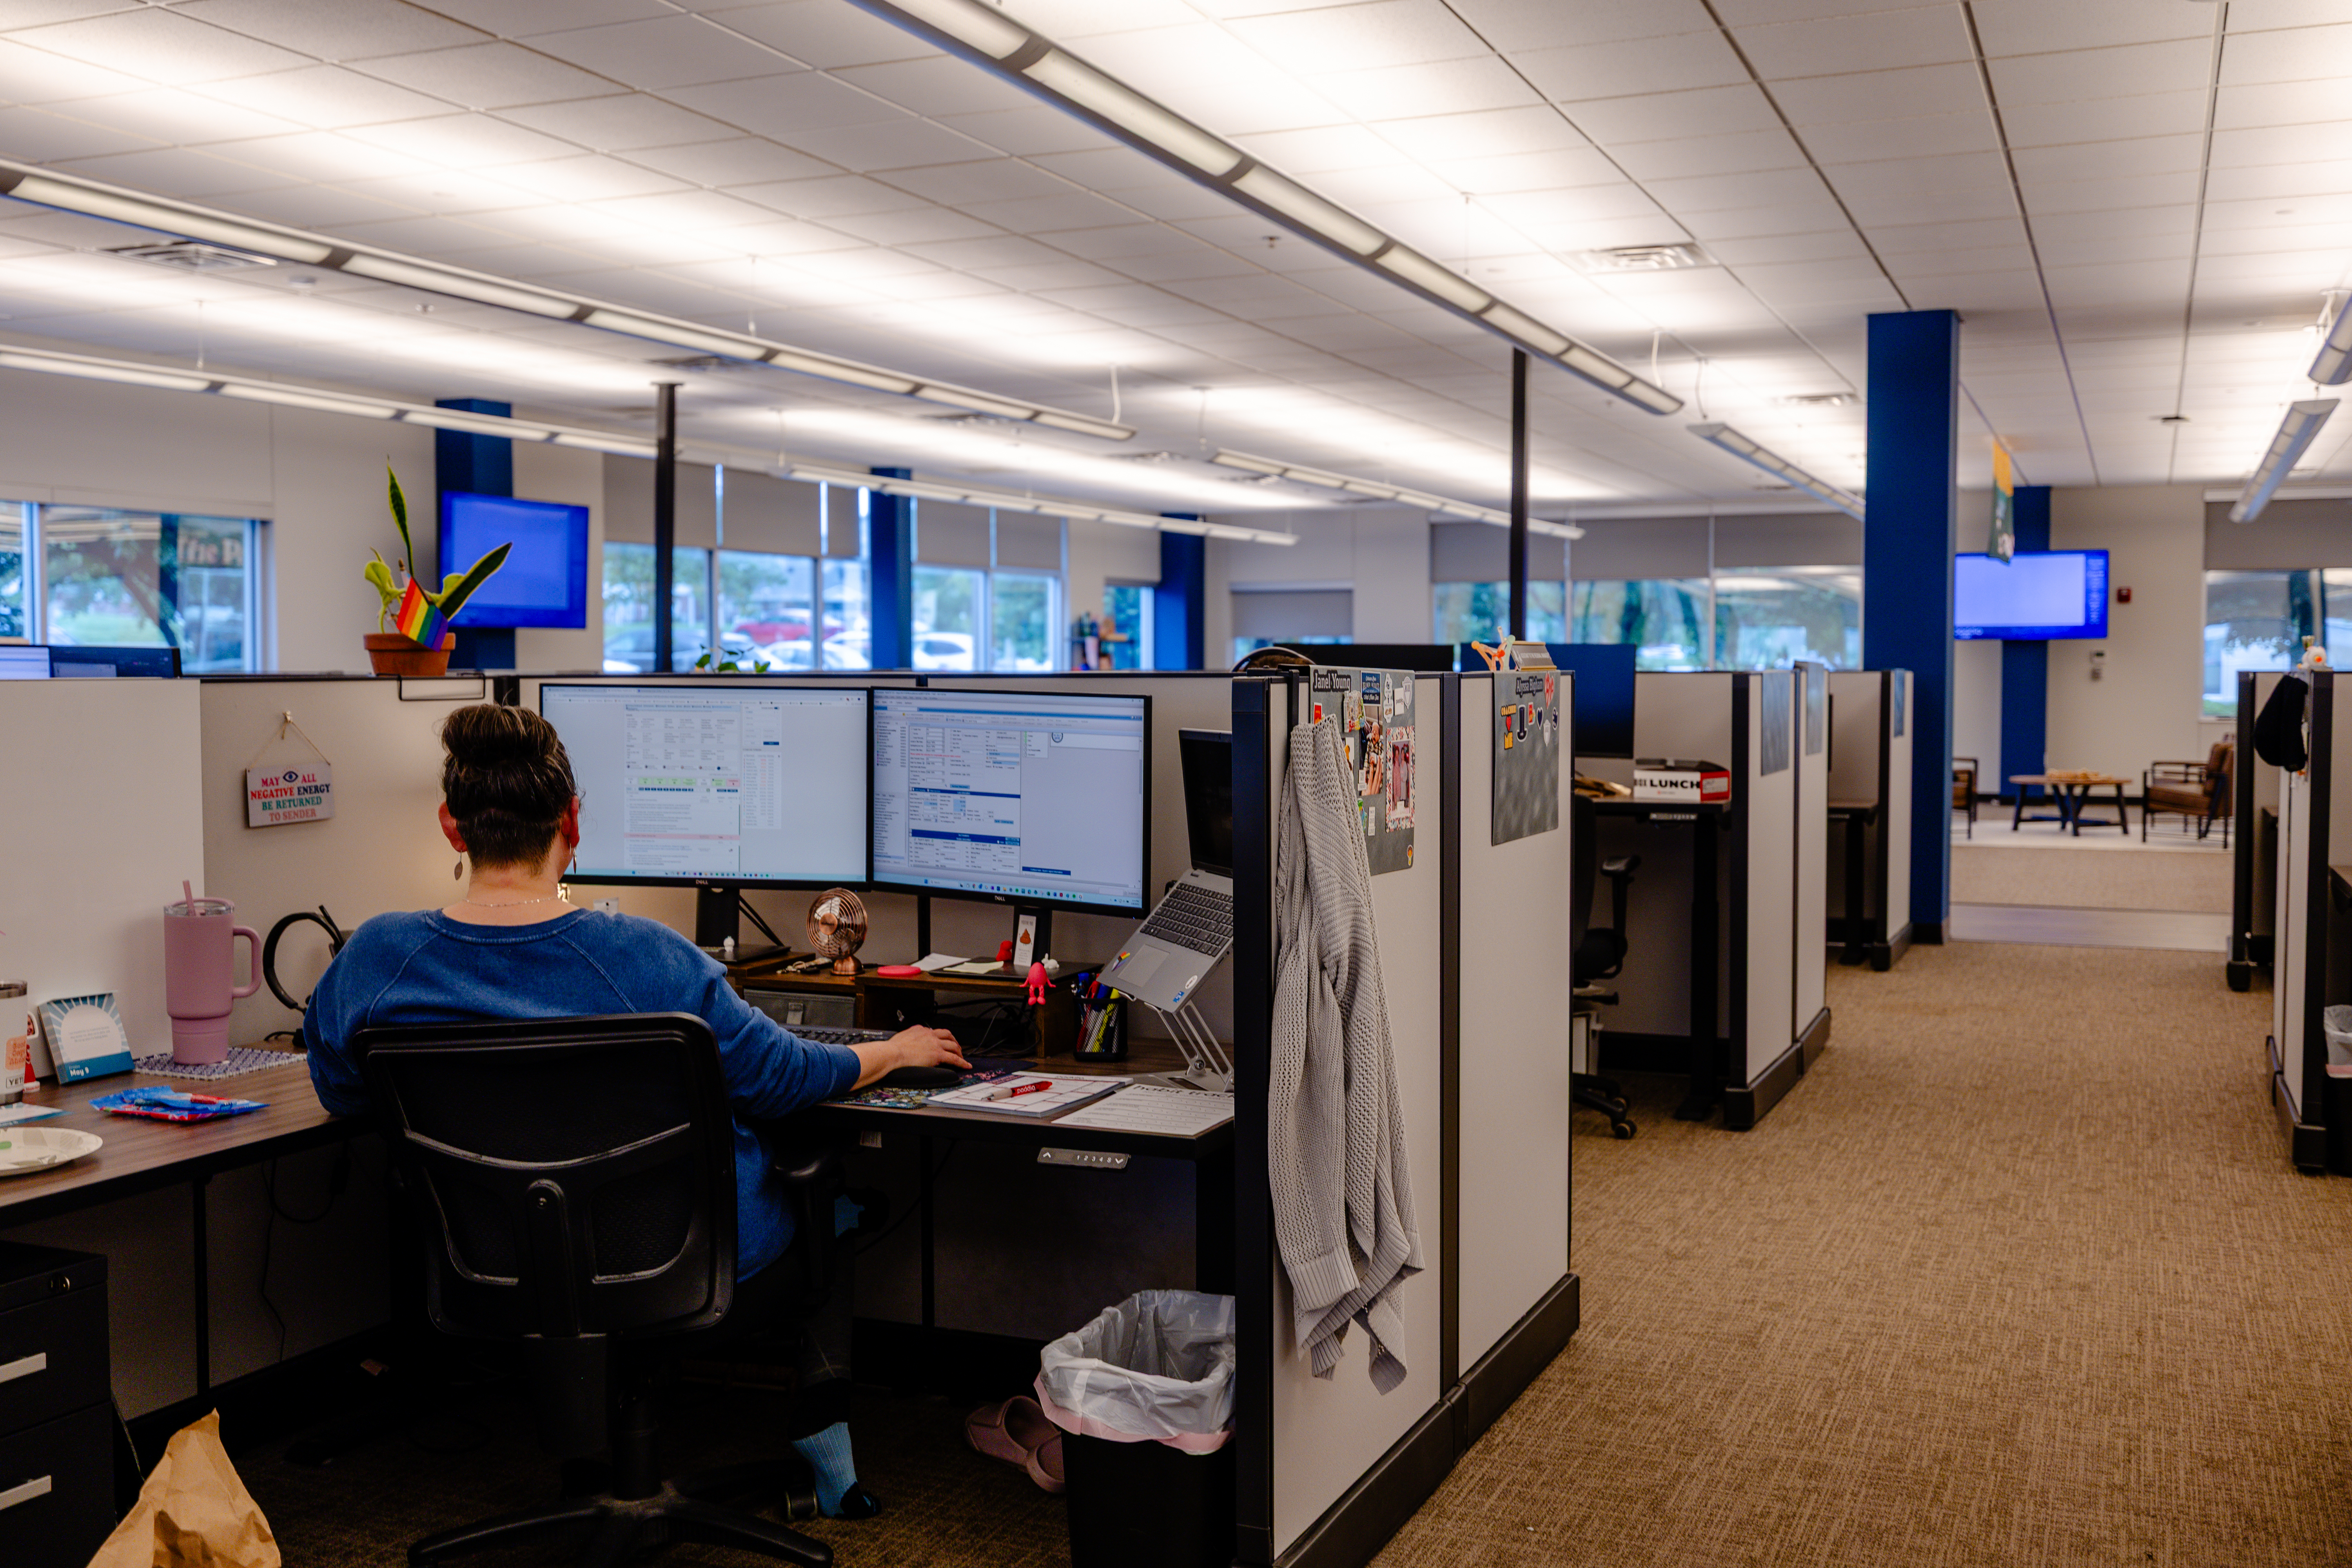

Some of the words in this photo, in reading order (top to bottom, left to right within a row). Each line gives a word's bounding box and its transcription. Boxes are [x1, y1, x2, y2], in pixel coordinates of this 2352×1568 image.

[1314, 672, 1331, 689] Janel
[1331, 673, 1350, 693] Young
[1516, 679, 1529, 697] Alyssa
[261, 777, 280, 787] MAY
[301, 774, 317, 784] ALL
[1650, 779, 1700, 789] LUNCH
[250, 787, 294, 800] NEGATIVE
[297, 784, 330, 796] ENERGY
[262, 801, 273, 811] BE
[276, 796, 322, 809] RETURNED
[269, 812, 281, 822] TO
[283, 808, 316, 820] SENDER
[70, 1069, 84, 1077] May
